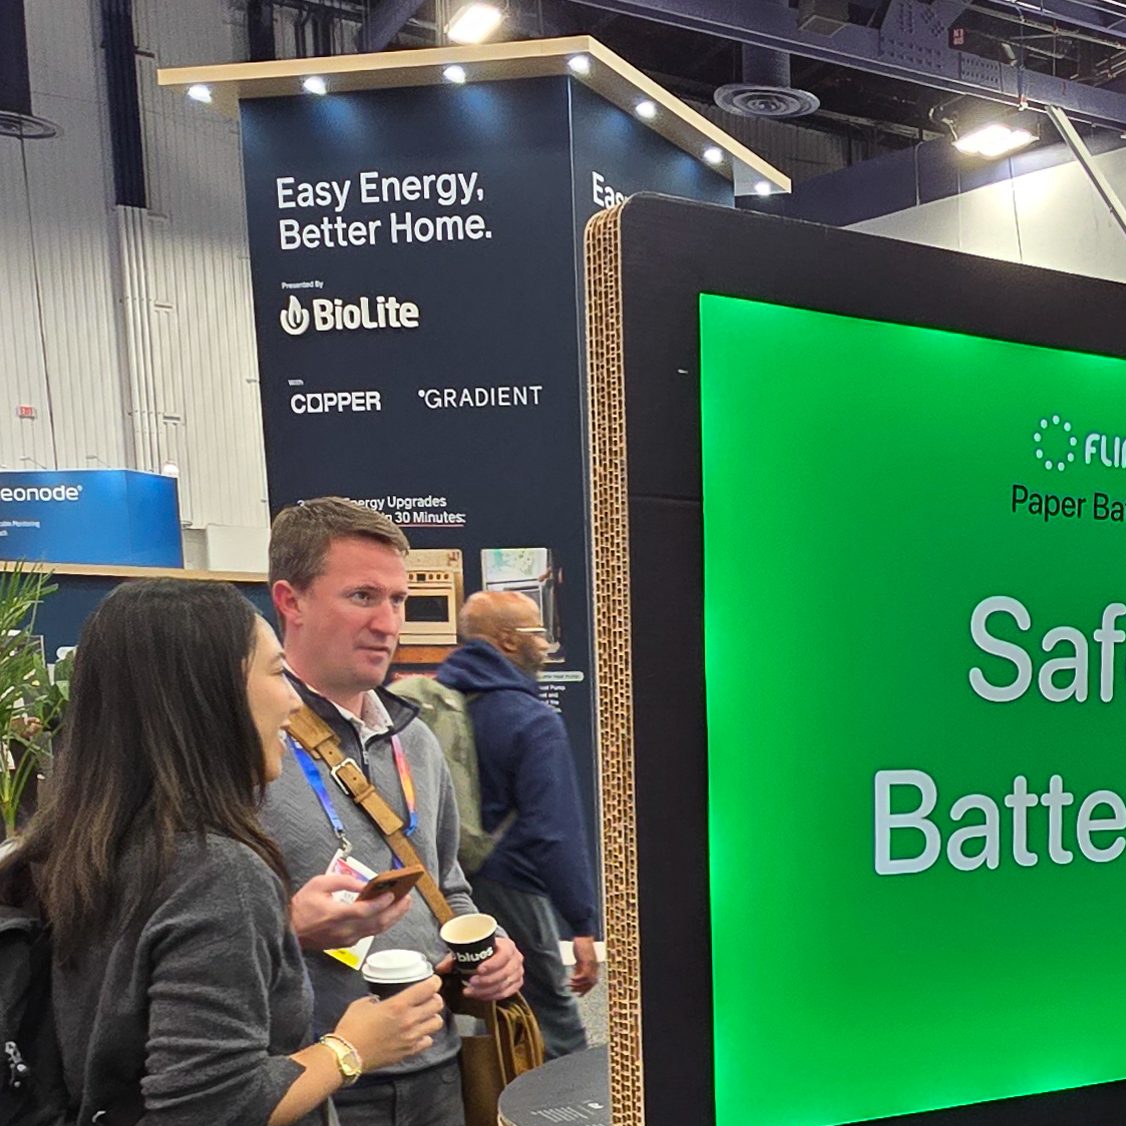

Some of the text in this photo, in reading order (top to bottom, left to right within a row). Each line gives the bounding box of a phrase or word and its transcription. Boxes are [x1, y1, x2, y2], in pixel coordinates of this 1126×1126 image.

[277, 172, 484, 212] Easy Energy,
[279, 212, 493, 250] Better Home.
[312, 296, 420, 331] BioLite
[290, 391, 382, 414] COPPER
[387, 496, 447, 510] Upgrades
[394, 511, 411, 524] 30
[1012, 484, 1087, 523] Paper
